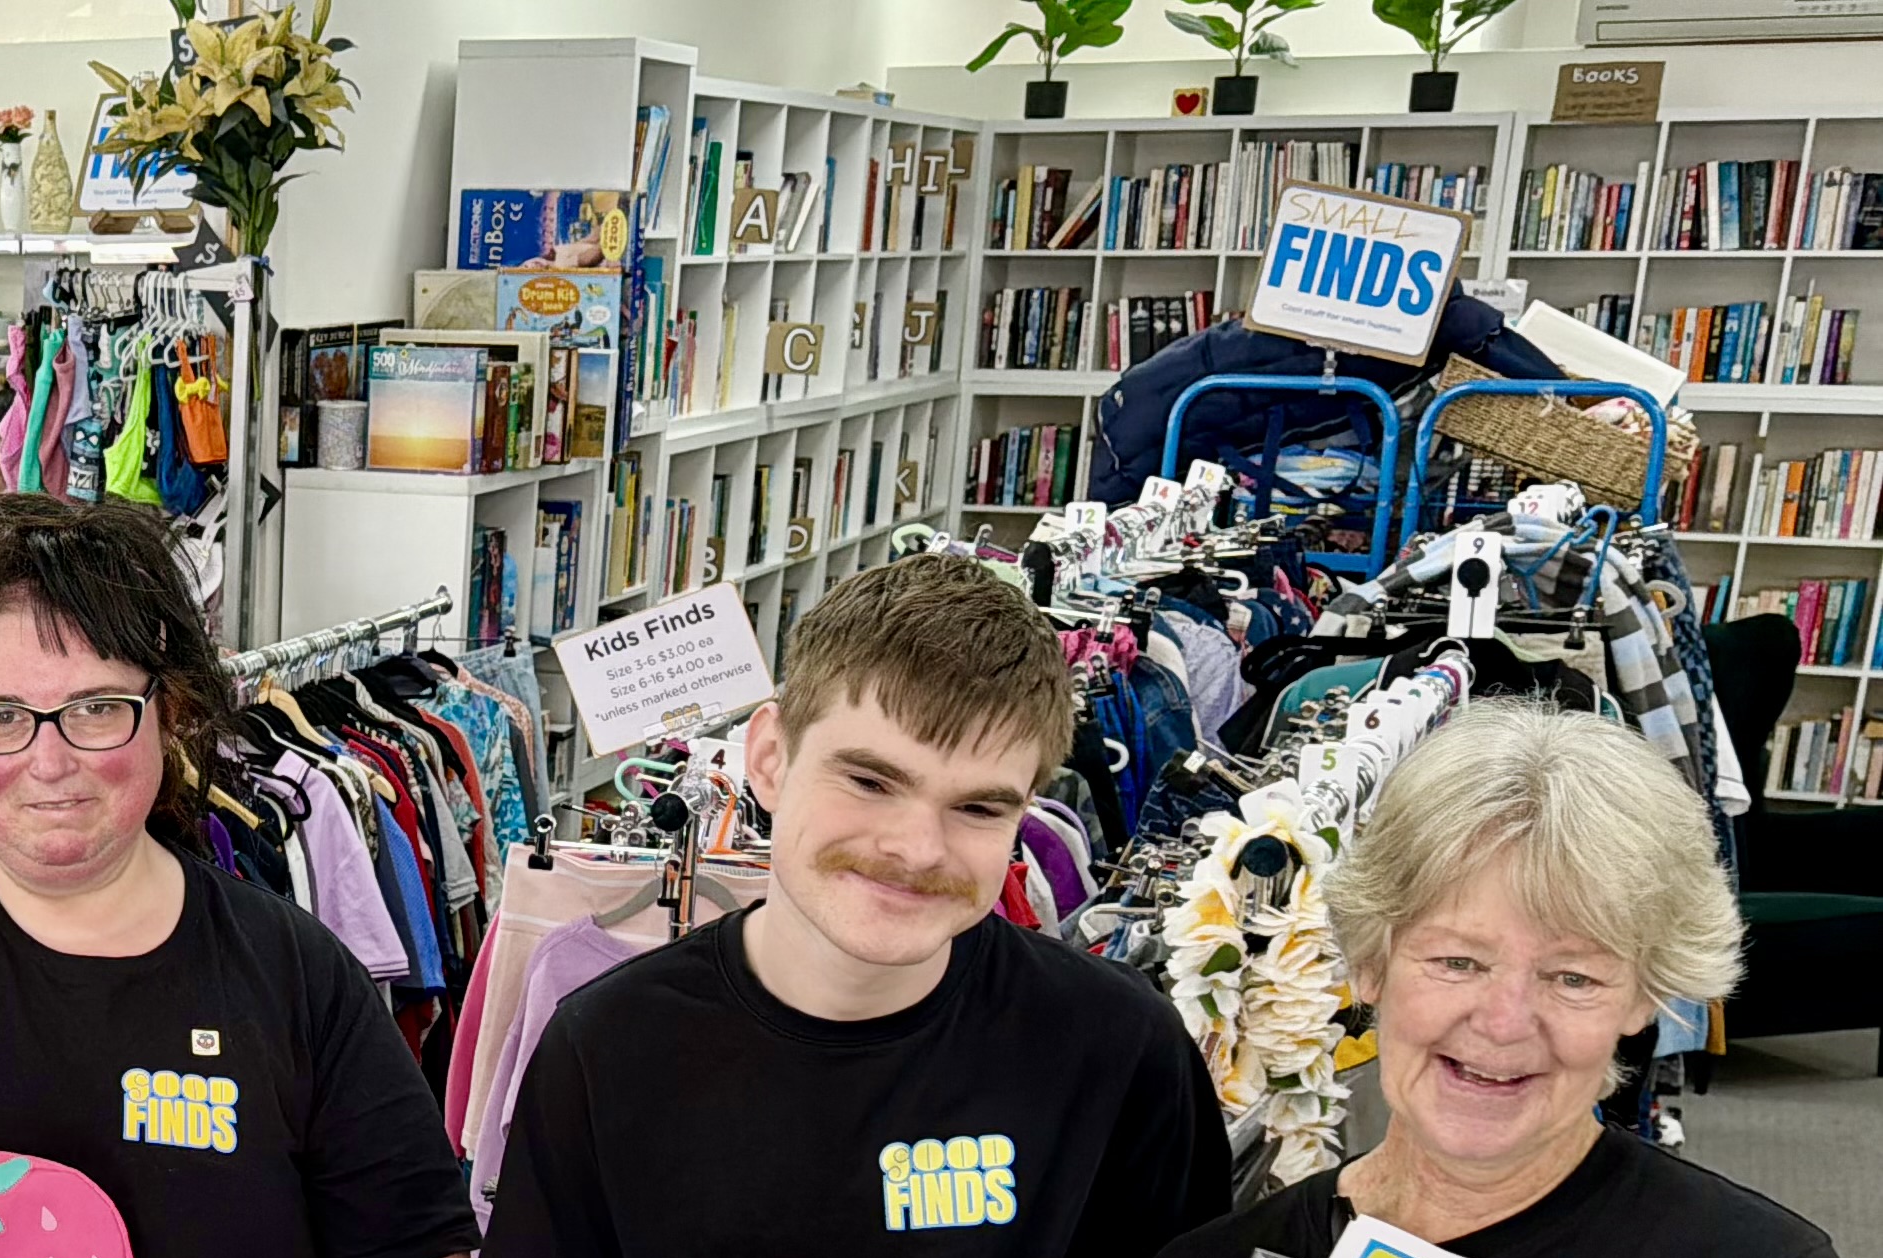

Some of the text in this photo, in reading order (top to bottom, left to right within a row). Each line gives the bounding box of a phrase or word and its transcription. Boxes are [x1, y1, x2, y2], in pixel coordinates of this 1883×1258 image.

[1573, 67, 1639, 84] BOOKS
[886, 147, 912, 183] H
[921, 155, 945, 192] I
[484, 200, 506, 269] inBox
[735, 195, 769, 239] A
[1289, 193, 1418, 239] SMALL
[1267, 223, 1443, 316] FINDS
[522, 286, 577, 301] Drum Kit
[904, 310, 934, 342] J
[1326, 311, 1340, 320] for
[1342, 314, 1365, 325] small
[373, 351, 396, 367] 500
[783, 328, 816, 370] C
[1152, 482, 1169, 499] 14
[1199, 466, 1214, 483] 16
[1076, 508, 1095, 524] 12
[1473, 537, 1485, 554] 9
[584, 603, 716, 661] Kids Finds
[606, 636, 715, 681] Size 3-6 $3.00 ea
[610, 653, 724, 699] Size 6-16 $4.00 ea
[641, 683, 687, 708] marked
[691, 662, 753, 691] otherwise
[1365, 709, 1381, 729] 6
[710, 749, 727, 770] 4
[1320, 748, 1337, 771] 5
[121, 1068, 239, 1105] GOOD
[123, 1096, 238, 1153] FINDS
[879, 1134, 1016, 1183] GOOD
[883, 1167, 1017, 1231] FINDS
